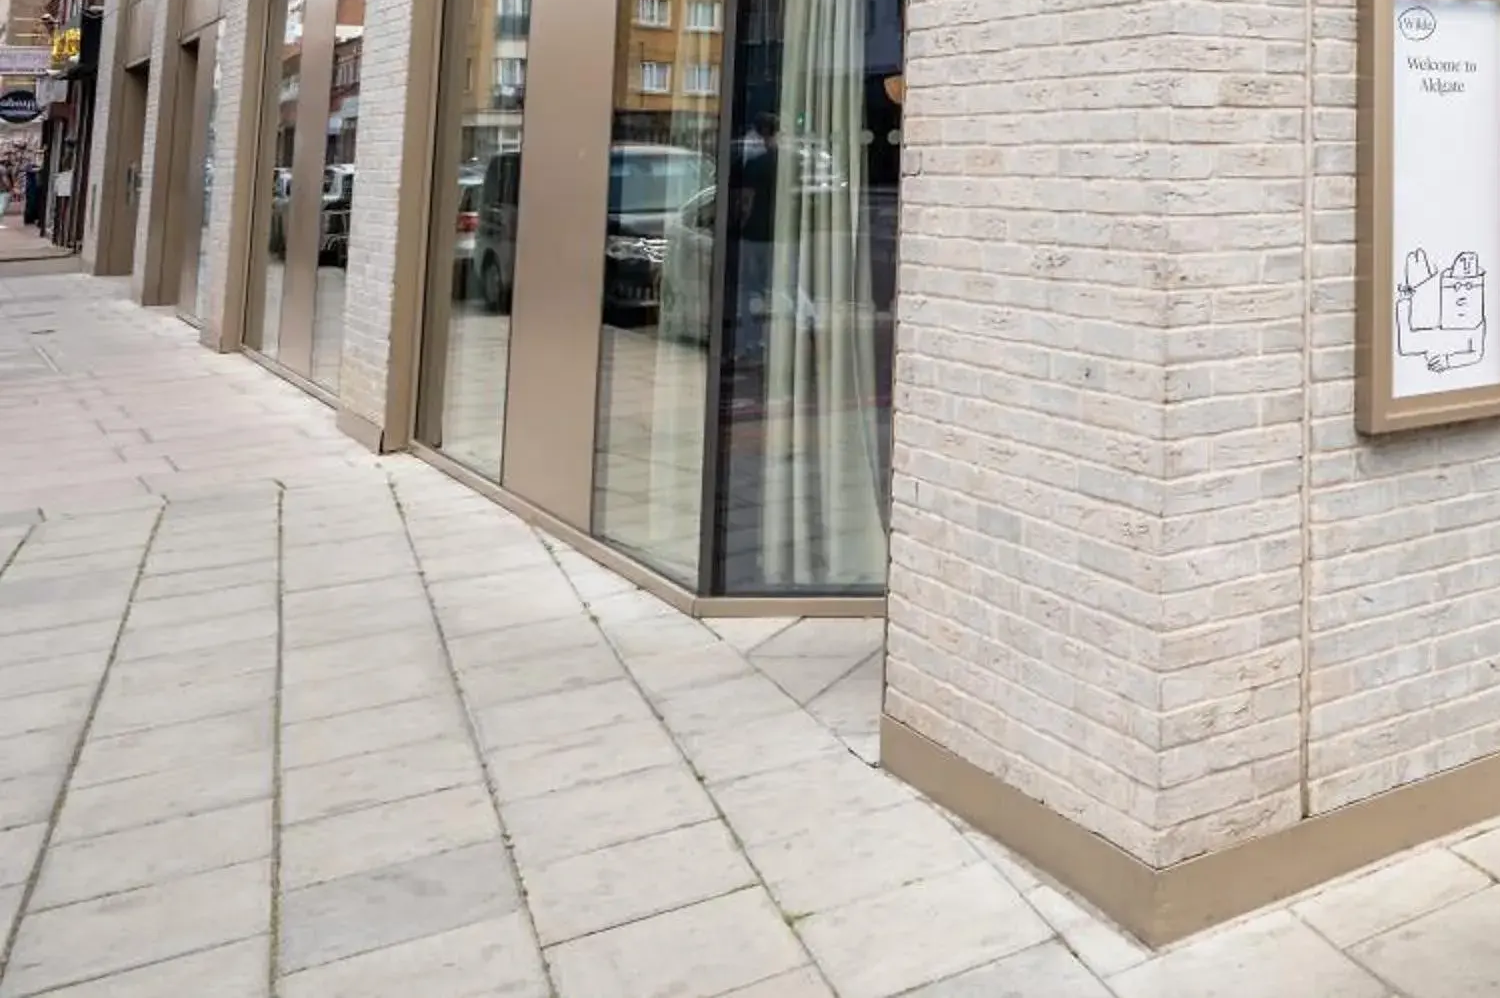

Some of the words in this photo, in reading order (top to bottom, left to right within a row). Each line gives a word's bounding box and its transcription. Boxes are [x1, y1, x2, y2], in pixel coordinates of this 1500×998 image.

[1407, 57, 1460, 73] Welcome
[1464, 61, 1477, 73] to
[1420, 77, 1465, 96] Aldgate
